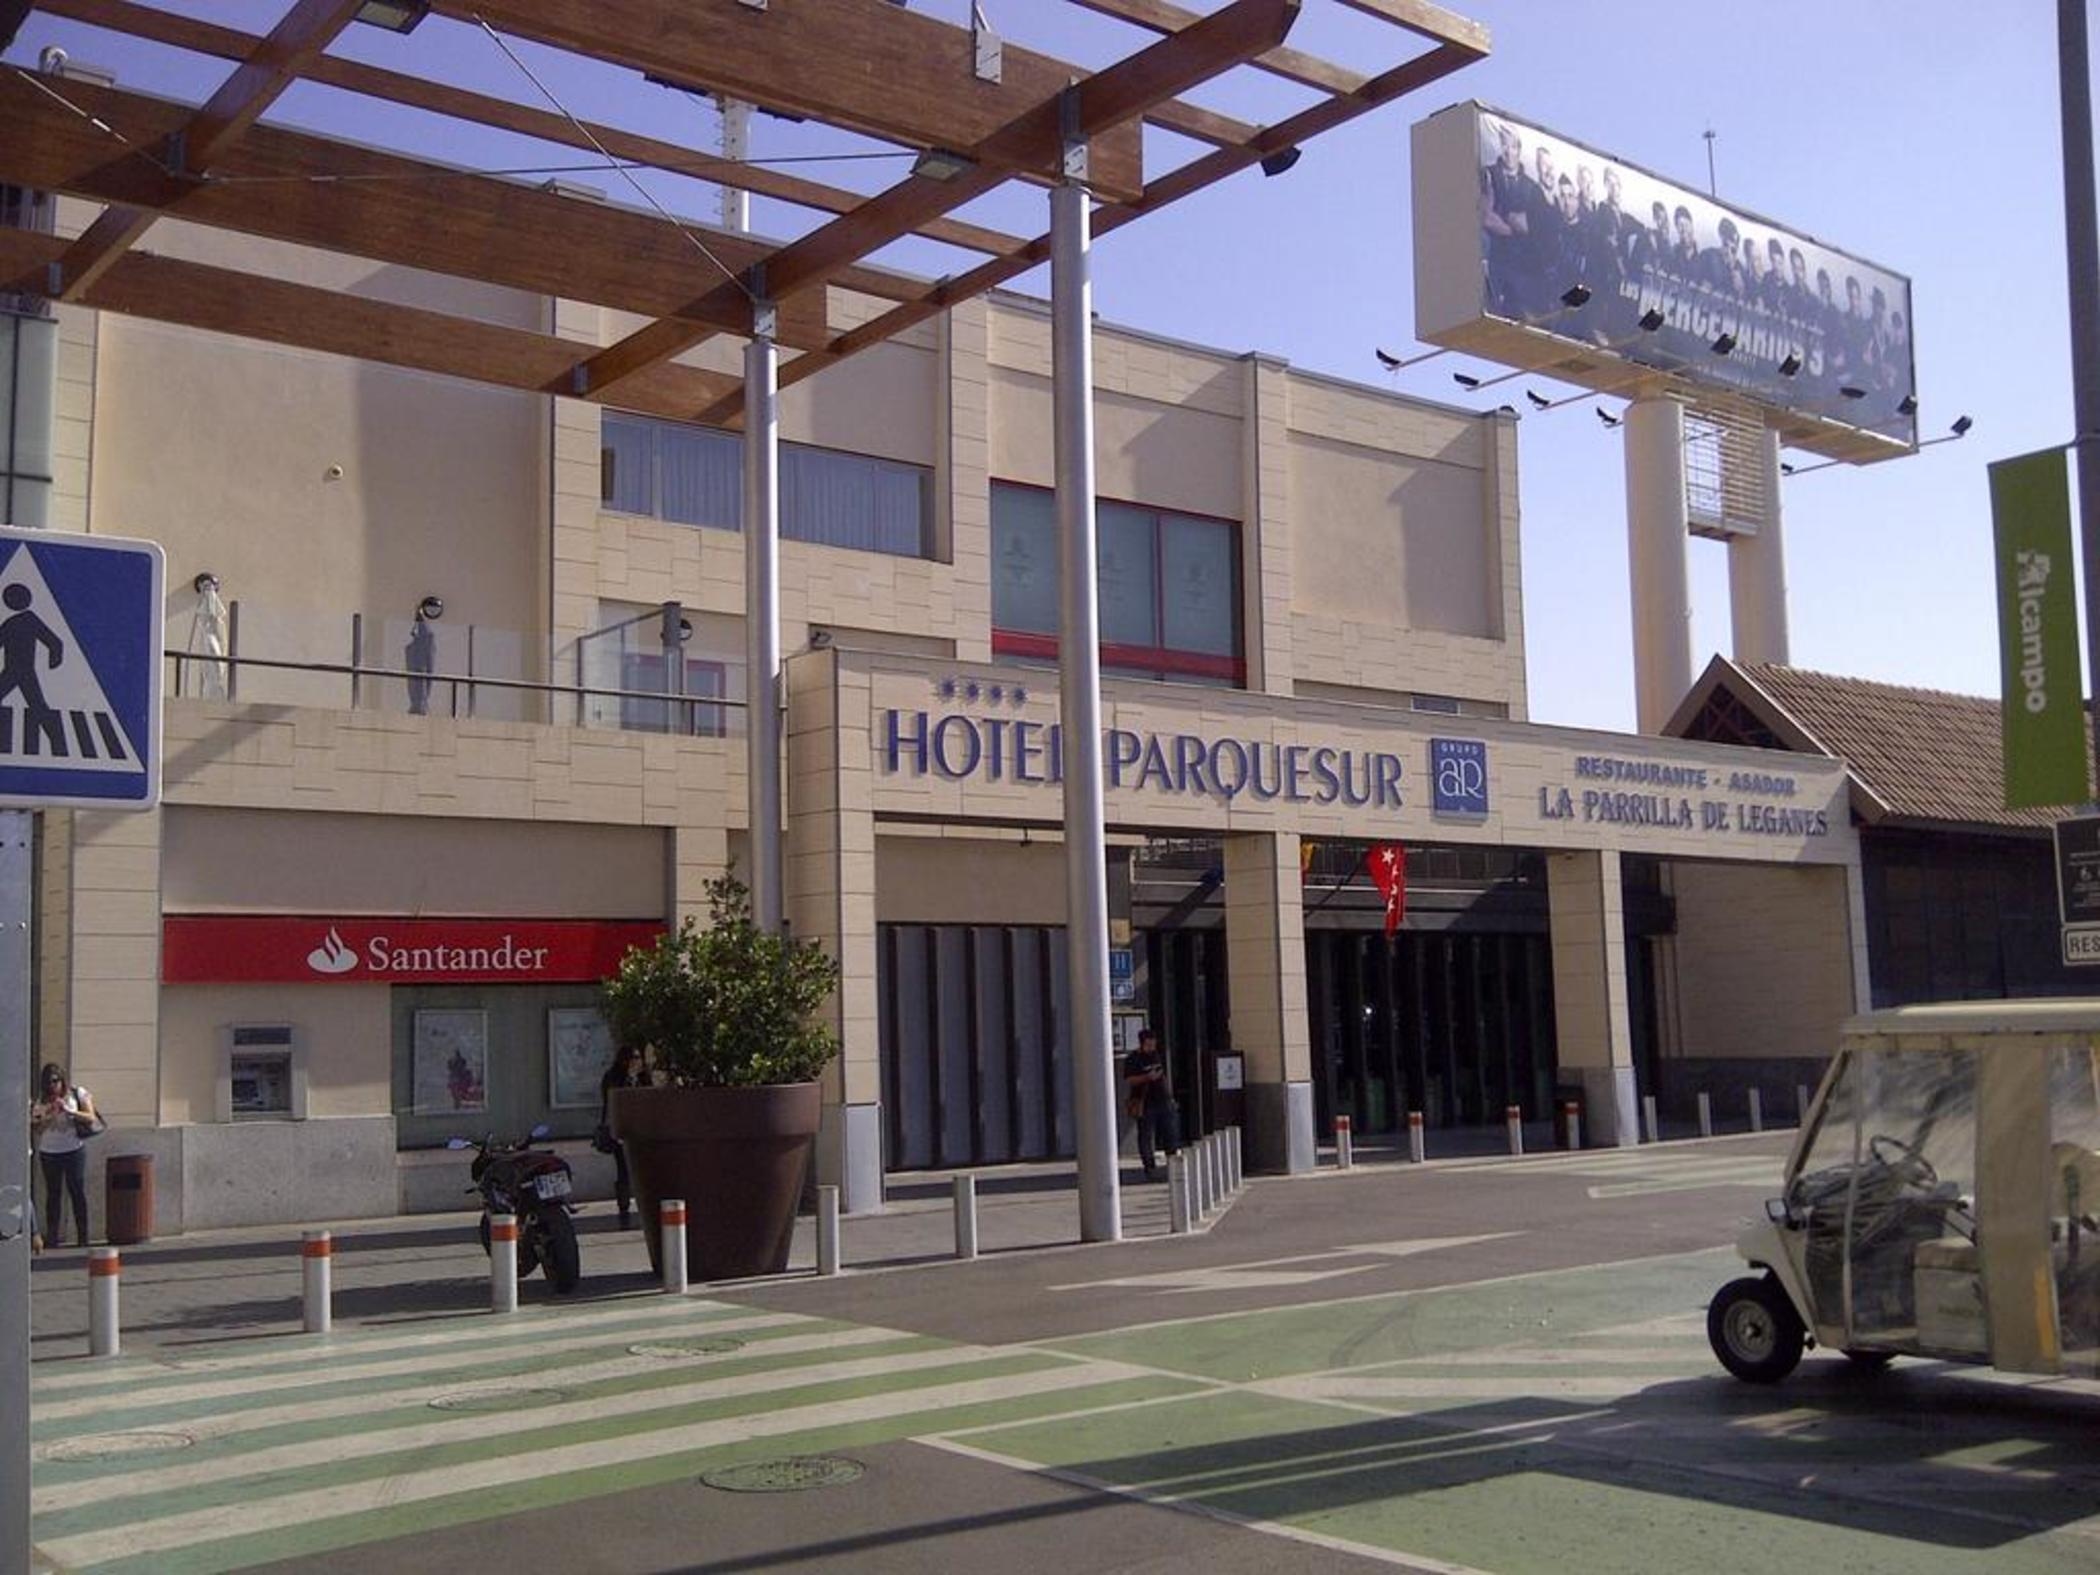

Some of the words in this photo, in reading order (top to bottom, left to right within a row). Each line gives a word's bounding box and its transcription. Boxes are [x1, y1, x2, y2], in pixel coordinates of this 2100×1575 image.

[2017, 551, 2050, 713] Alcampo
[1109, 729, 1404, 808] PARQUESUR
[1575, 756, 1708, 789] RESTAURANTE
[1728, 771, 1796, 797] ASADOR
[1540, 786, 1575, 820] LA
[1582, 790, 1694, 831] PARRILLA
[1702, 801, 1730, 832] DE
[1738, 803, 1829, 837] LEGANES
[368, 934, 548, 972] Santander
